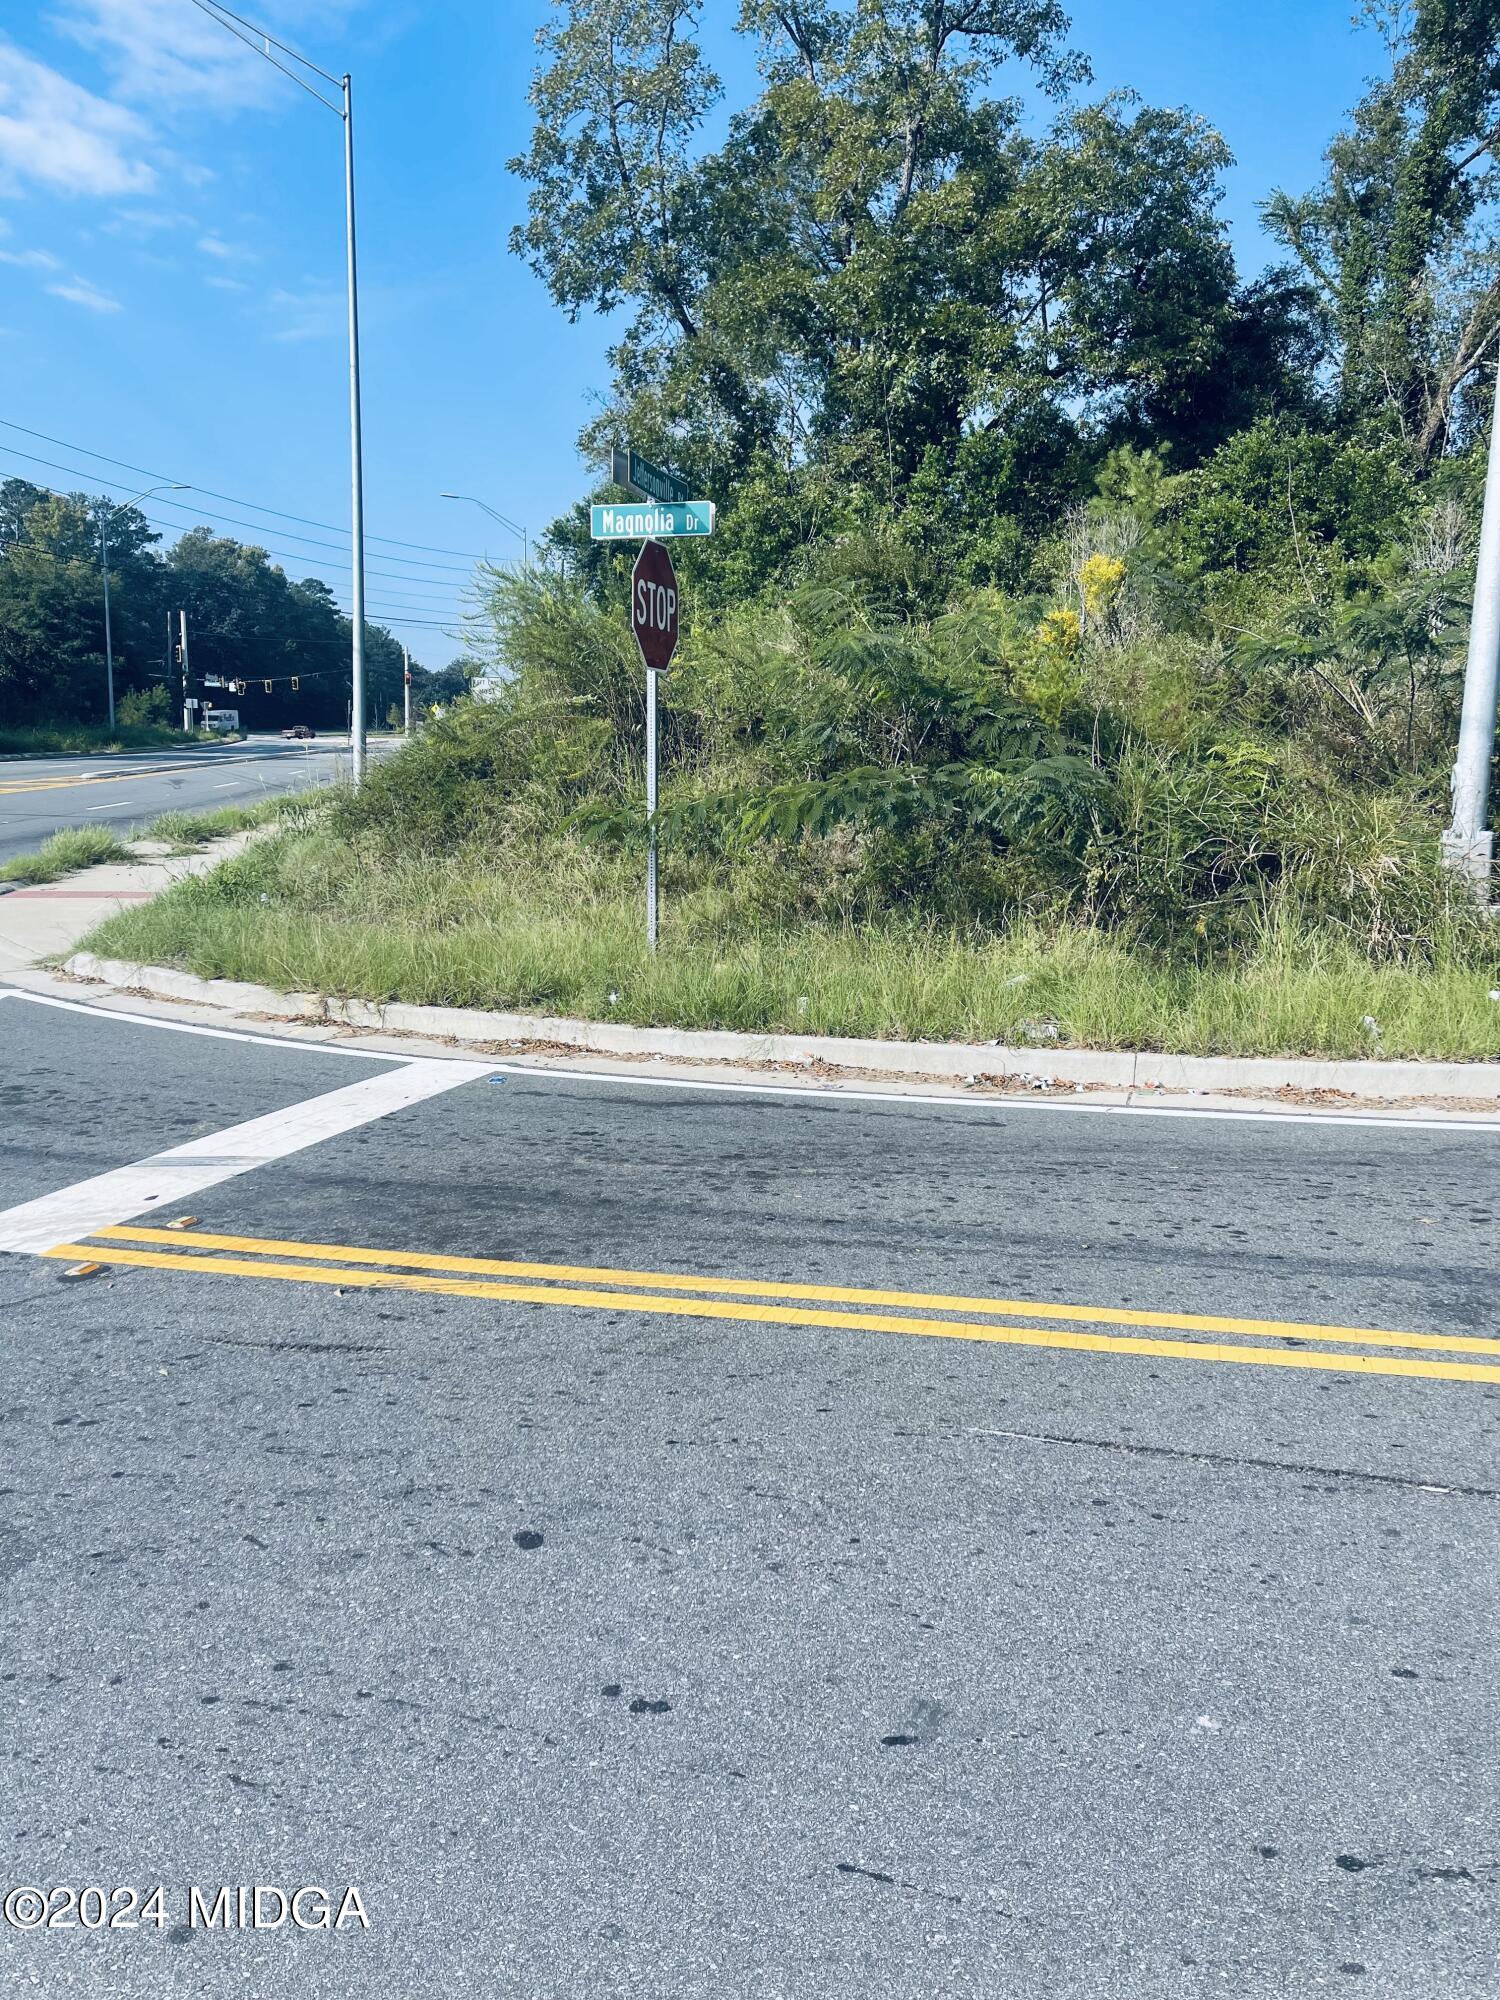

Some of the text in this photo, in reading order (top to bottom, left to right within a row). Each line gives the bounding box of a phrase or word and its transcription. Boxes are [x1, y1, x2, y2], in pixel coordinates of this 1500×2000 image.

[632, 458, 674, 502] Jeffersonville
[602, 508, 699, 536] Magnolia Dr
[637, 578, 676, 632] STOP
